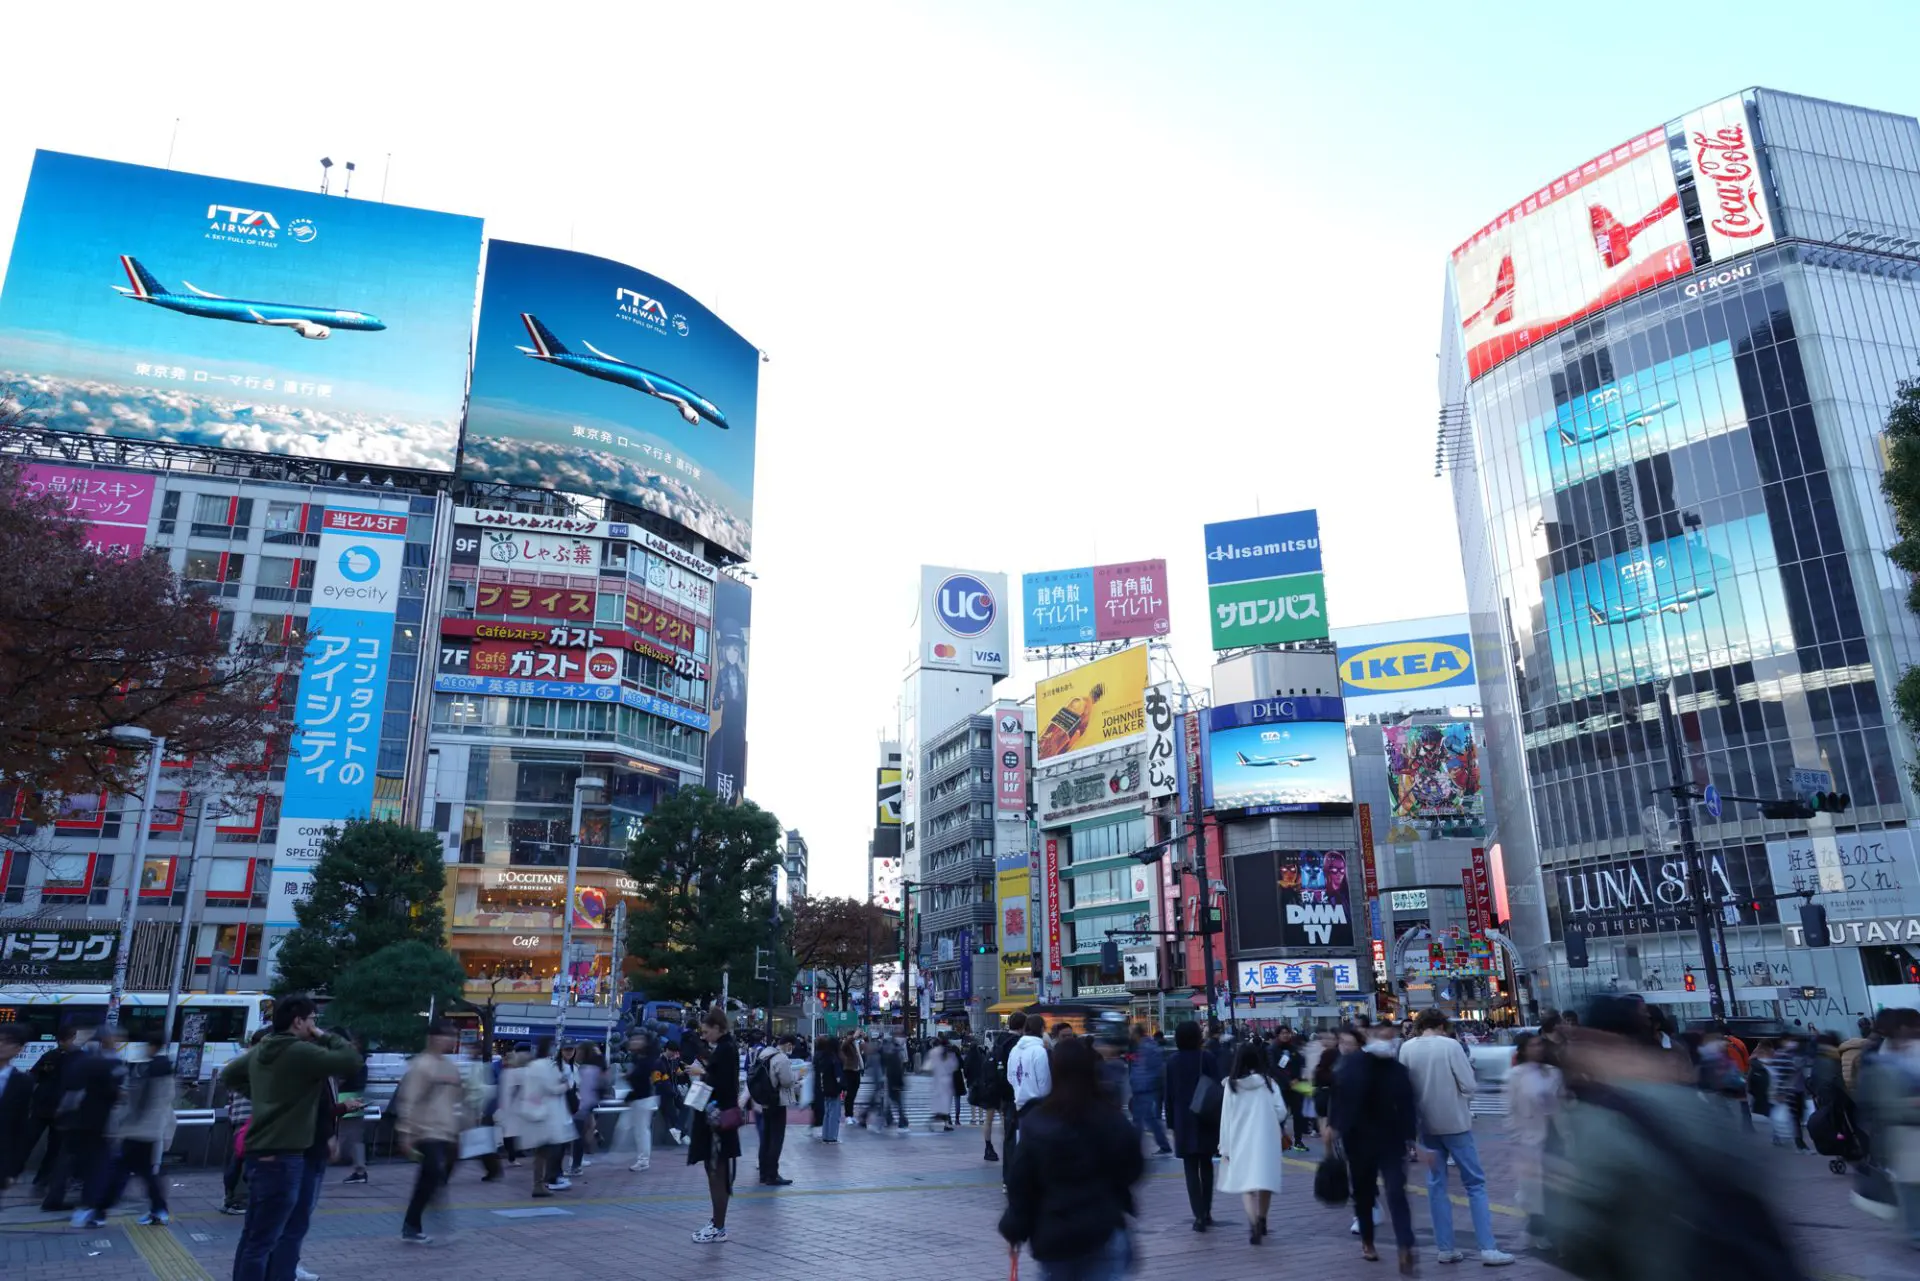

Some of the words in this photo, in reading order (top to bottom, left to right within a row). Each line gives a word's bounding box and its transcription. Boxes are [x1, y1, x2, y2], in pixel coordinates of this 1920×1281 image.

[207, 204, 280, 229] ITA
[210, 222, 276, 238] AIRWAYS
[1685, 263, 1752, 297] QFRONT
[616, 287, 668, 319] ITA
[619, 304, 665, 326] AIRWAYS
[134, 363, 187, 381] 東京発
[193, 370, 275, 391] ローマ行き
[572, 425, 612, 444] 東京発
[618, 436, 672, 464] ローマ行き
[331, 513, 399, 530] 当ビル5F
[475, 510, 598, 533] しゃぶしゃぶバイキング
[455, 538, 478, 552] 9F
[523, 539, 592, 565] しゃぶ葉
[1208, 538, 1318, 561] Hisamitsu
[323, 585, 388, 603] eyecity
[1038, 584, 1080, 605] 龍角散
[1109, 576, 1153, 598] 龍角散
[480, 587, 591, 614] プライス
[1217, 593, 1320, 628] サロンパス
[626, 599, 691, 642] コンタクト
[549, 626, 604, 648] ガスト
[442, 649, 469, 665] 7F
[475, 651, 507, 664] Café
[509, 650, 578, 678] ガスト
[592, 664, 615, 672] ガスト
[675, 653, 705, 679] ガスト
[975, 651, 1001, 662] VISA
[1349, 650, 1462, 681] IKEA
[441, 678, 477, 689] AEON
[488, 679, 591, 697] 英会話イーオン
[302, 635, 352, 785] アイシティ
[338, 638, 381, 786] コンタクトの
[652, 699, 709, 728] 英会話イーオン
[1102, 707, 1144, 729] JOHNNIE
[1252, 701, 1294, 717] DHC
[1102, 718, 1144, 738] WALKER
[1146, 686, 1176, 792] もんじゃ
[498, 871, 564, 884] L'OCCITANE
[1474, 855, 1488, 904] カラオケ
[1564, 865, 1654, 913] LUNA
[1048, 853, 1058, 934] ウィンターフルーツギフト
[1286, 904, 1347, 924] DMM
[512, 936, 540, 949] Café
[1303, 924, 1332, 944] TV
[1787, 919, 1920, 946] TUTAYA
[0, 933, 115, 961] ドラッグ
[1749, 997, 1857, 1017] ENEWAL
